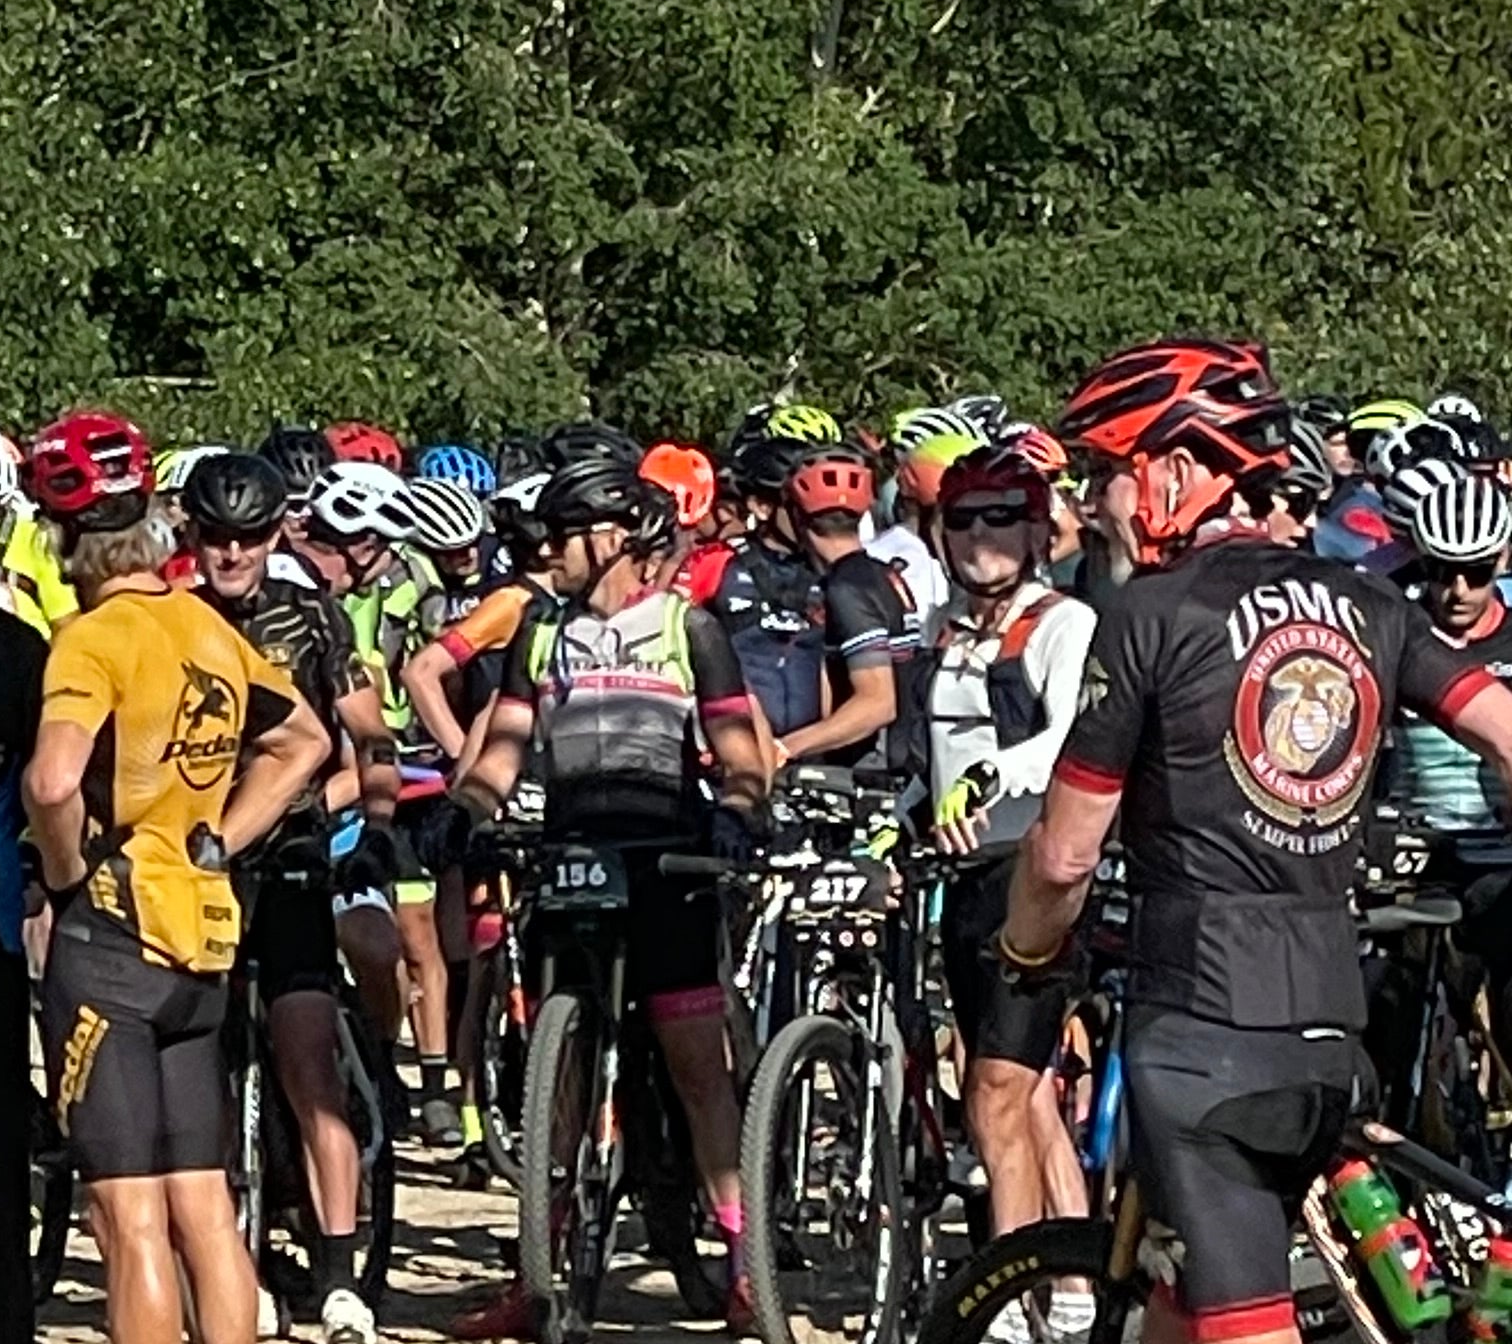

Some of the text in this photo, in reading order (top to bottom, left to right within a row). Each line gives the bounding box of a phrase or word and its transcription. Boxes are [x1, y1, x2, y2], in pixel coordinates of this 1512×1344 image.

[1226, 579, 1372, 661] USMC
[556, 862, 608, 888] 156
[809, 877, 868, 903] 217
